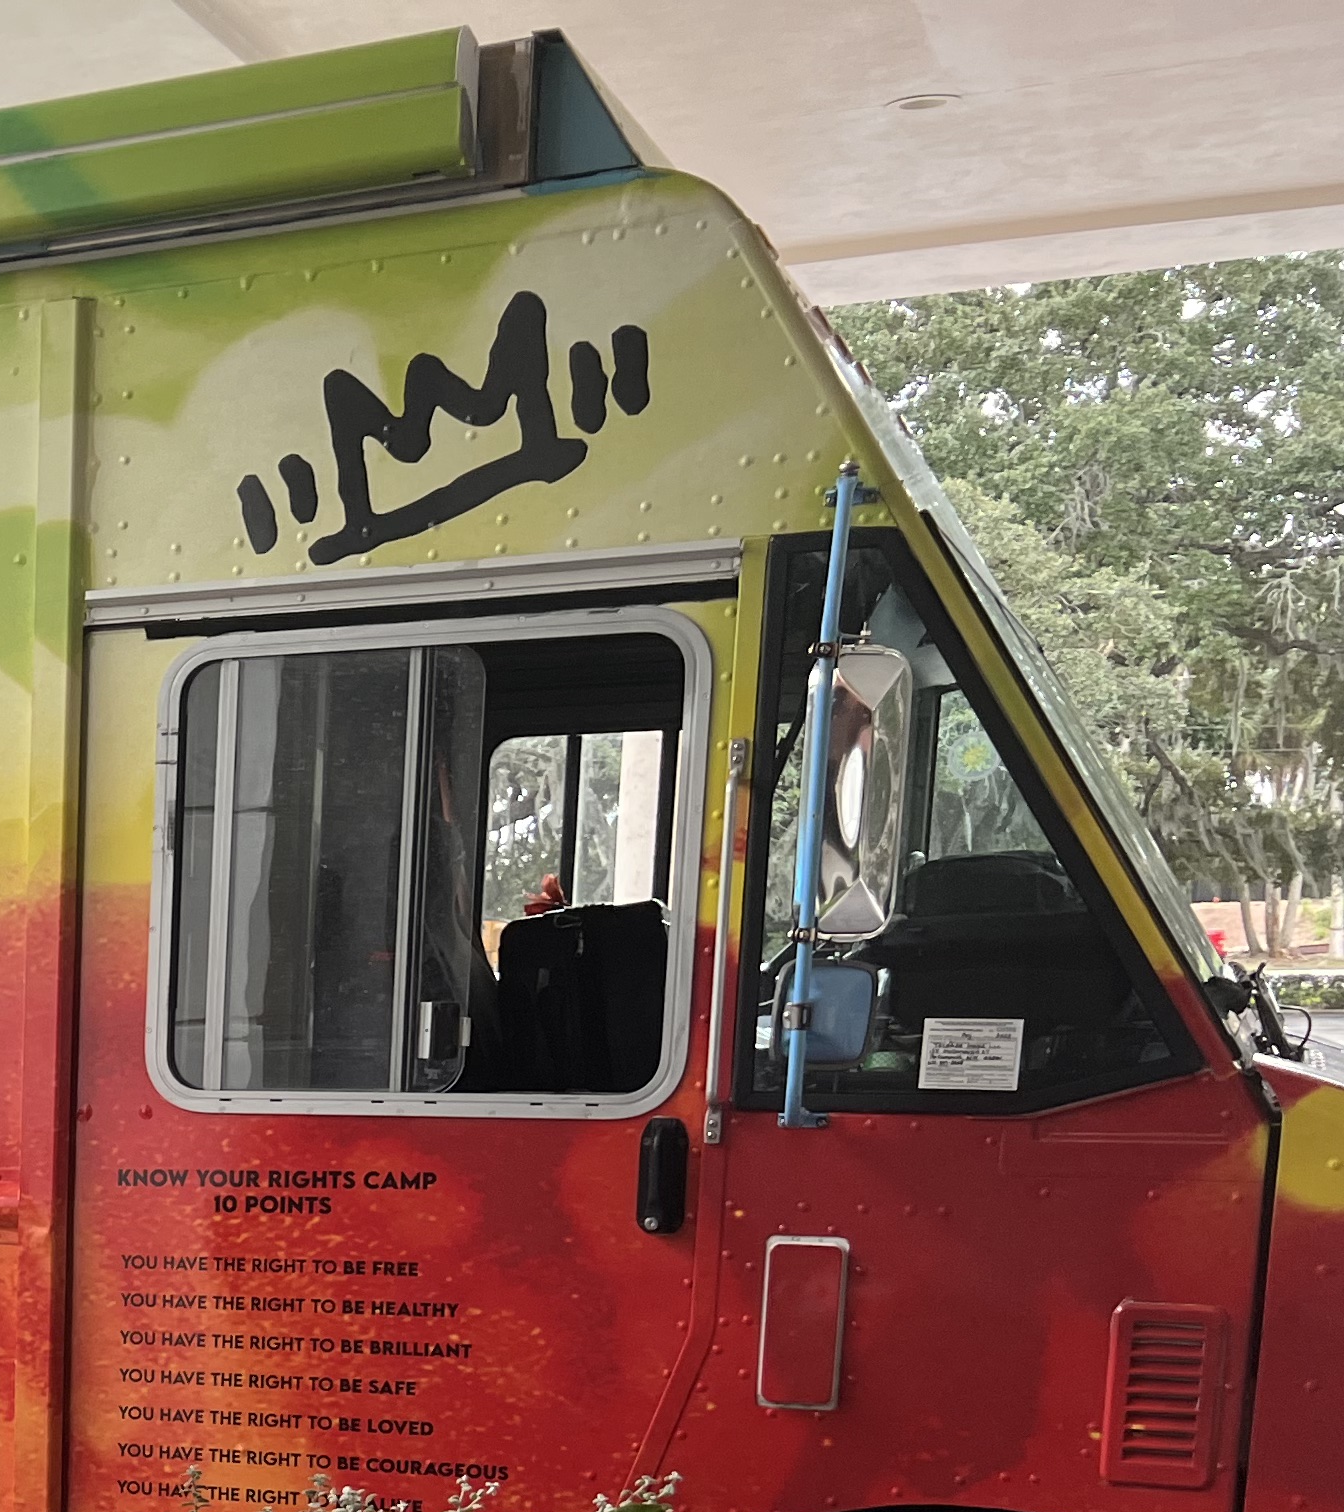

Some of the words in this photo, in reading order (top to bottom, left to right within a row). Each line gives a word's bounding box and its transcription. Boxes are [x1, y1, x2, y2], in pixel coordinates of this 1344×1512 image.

[118, 1169, 188, 1188] KNOW
[197, 1169, 260, 1188] YOUR
[268, 1170, 356, 1190] RIGHTS
[364, 1171, 438, 1191] CAMP
[214, 1195, 238, 1213] 10
[245, 1196, 332, 1215] POINTS
[122, 1255, 157, 1269] YOU
[164, 1256, 208, 1271] HAVE
[213, 1257, 246, 1272] THE
[252, 1259, 307, 1274] RIGHT
[312, 1260, 338, 1275] TO
[343, 1261, 367, 1276] BE
[372, 1261, 419, 1277] FREE
[121, 1293, 156, 1308] YOU
[163, 1295, 207, 1310] HAVE
[212, 1296, 245, 1311] THE
[251, 1297, 305, 1313] RIGHT
[311, 1299, 336, 1314] TO
[342, 1300, 365, 1315] BE
[371, 1301, 459, 1318] HEALTHY
[120, 1330, 156, 1345] YOU
[162, 1332, 206, 1347] HAVE
[212, 1334, 244, 1349] THE
[250, 1336, 305, 1352] RIGHT
[310, 1338, 335, 1353] TO
[341, 1339, 364, 1354] BE
[370, 1340, 472, 1359] BRILLIANT
[120, 1368, 155, 1383] YOU
[161, 1370, 205, 1386] HAVE
[211, 1373, 243, 1388] THE
[249, 1374, 304, 1391] RIGHT
[309, 1377, 334, 1392] TO
[339, 1378, 363, 1394] BE
[369, 1380, 417, 1396] SAFE
[119, 1406, 154, 1421] YOU
[160, 1408, 204, 1424] HAVE
[210, 1411, 242, 1426] THE
[248, 1413, 302, 1429] RIGHT
[308, 1416, 333, 1431] TO
[338, 1417, 362, 1433] BE
[368, 1418, 434, 1436] LOVED
[118, 1443, 153, 1458] YOU
[160, 1445, 203, 1461] HAVE
[209, 1448, 241, 1464] THE
[246, 1451, 301, 1467] RIGHT
[306, 1454, 332, 1470] TO
[337, 1456, 361, 1472] BE
[366, 1457, 509, 1481] COURAGEOUS
[117, 1480, 152, 1495] YOU
[208, 1486, 240, 1502] THE
[245, 1489, 300, 1506] RIGHT
